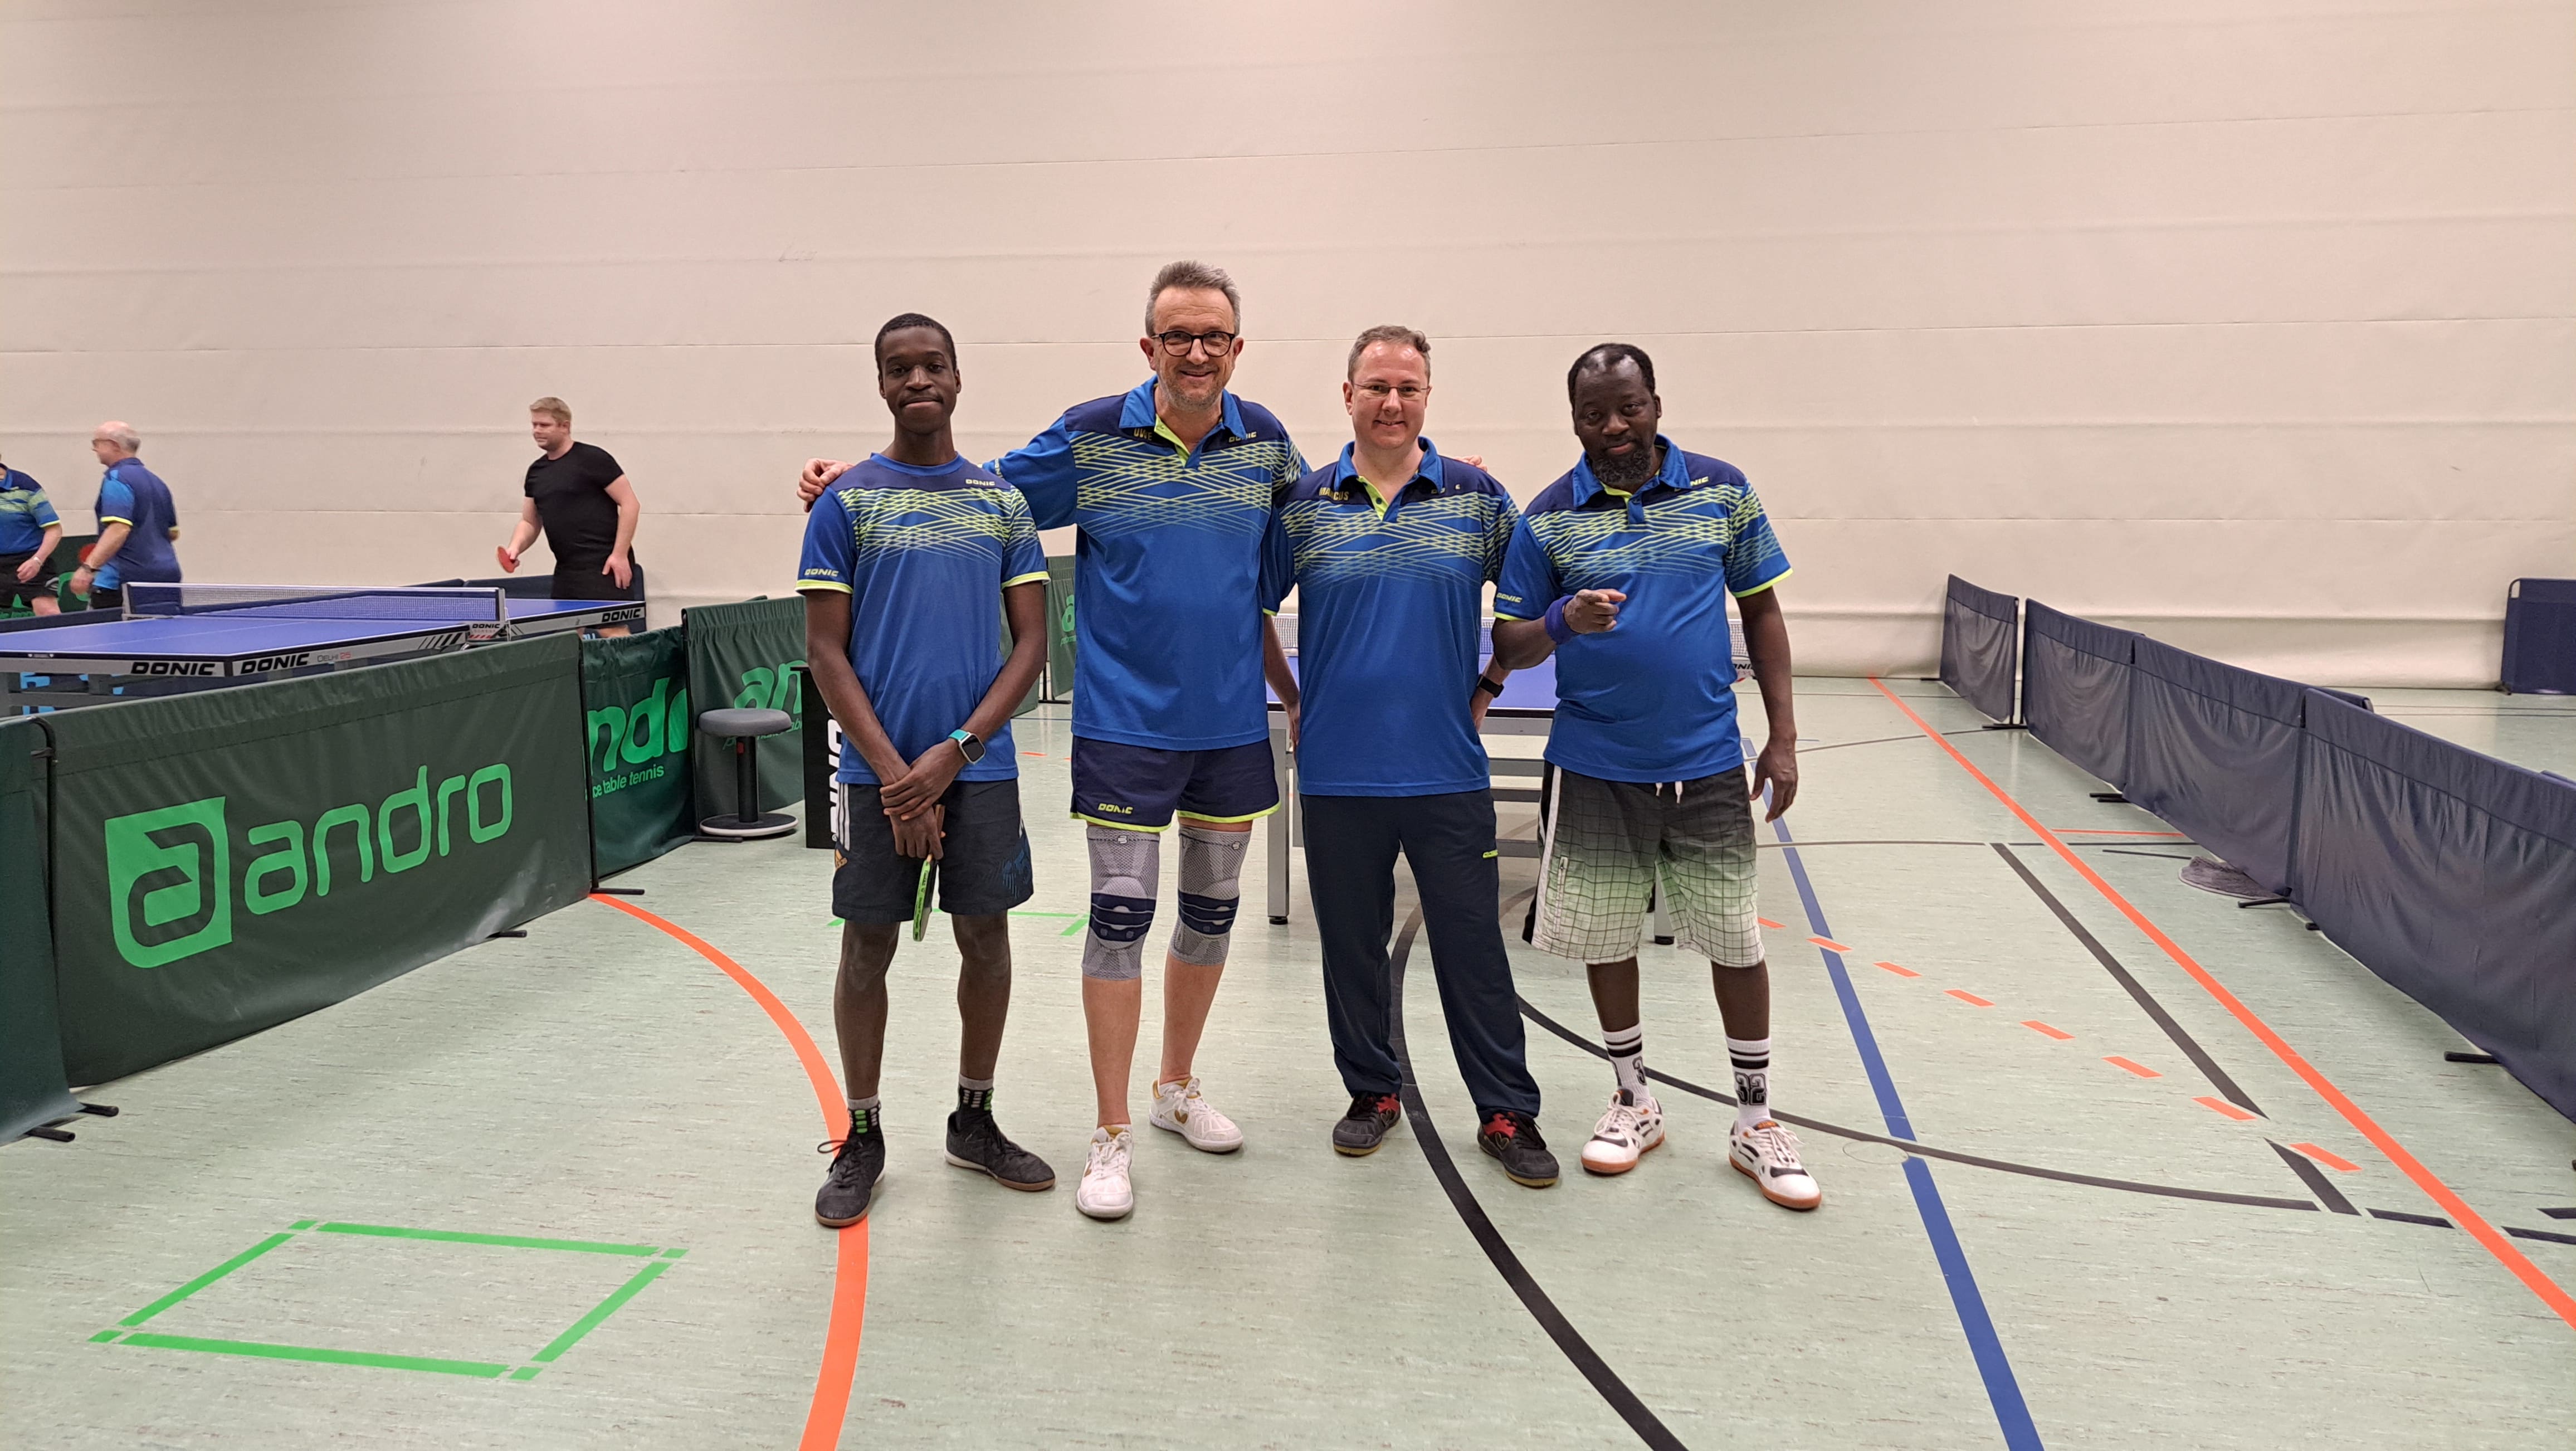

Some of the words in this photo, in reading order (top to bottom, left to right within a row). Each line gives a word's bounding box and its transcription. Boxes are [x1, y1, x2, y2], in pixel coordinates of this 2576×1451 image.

[1133, 427, 1153, 441] UWE
[1319, 487, 1349, 501] MARCUS
[804, 568, 840, 577] DONIC
[1496, 592, 1523, 603] DONIC
[601, 608, 641, 623] DONIC
[131, 661, 216, 676] DONIC
[240, 653, 310, 674] DONIC
[340, 651, 352, 660] 25
[603, 775, 627, 795] table
[629, 763, 665, 786] tennis
[1097, 803, 1134, 814] DONIC
[244, 762, 513, 916] andro
[1734, 1072, 1767, 1106] 32
